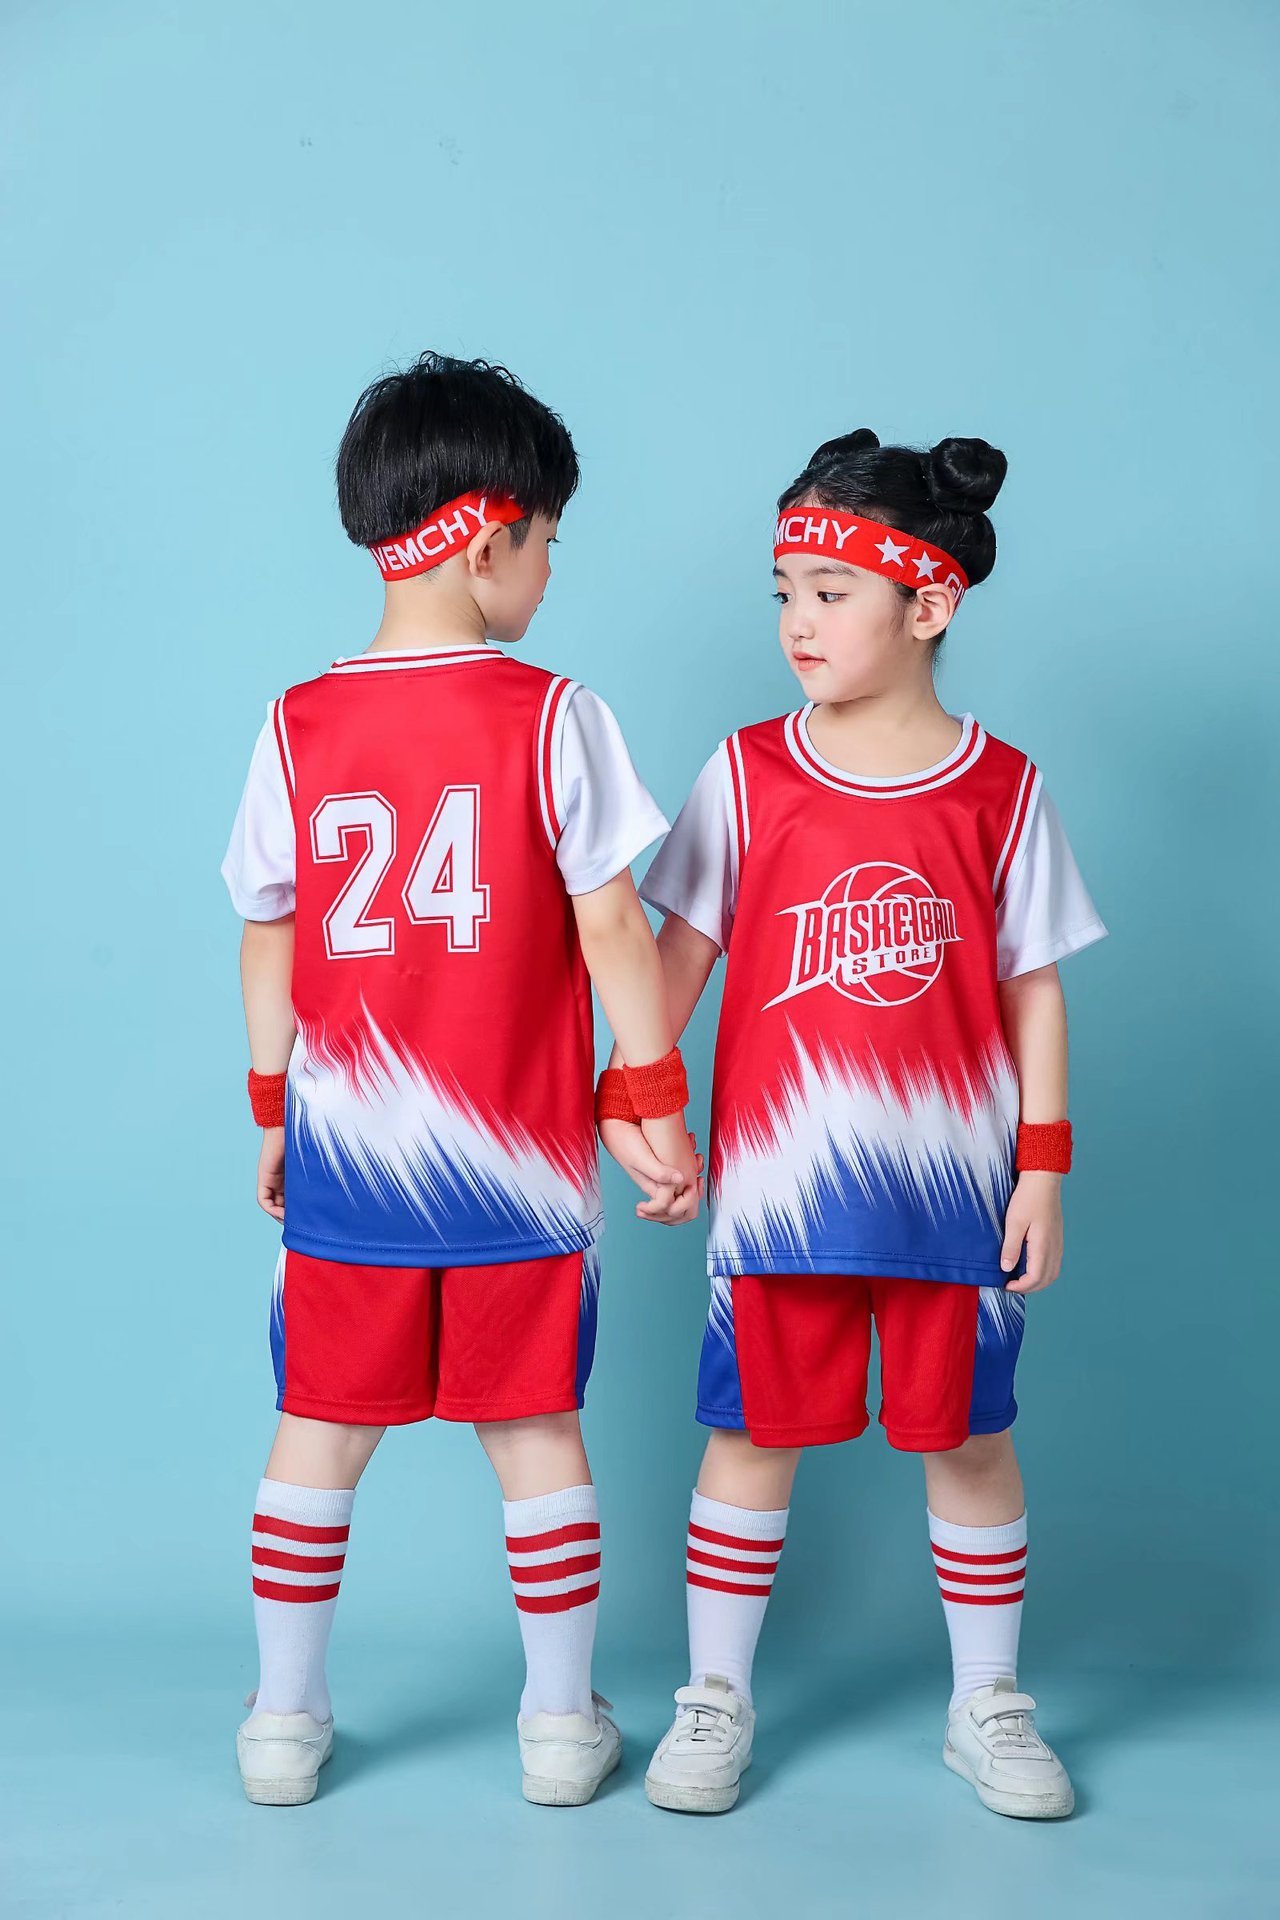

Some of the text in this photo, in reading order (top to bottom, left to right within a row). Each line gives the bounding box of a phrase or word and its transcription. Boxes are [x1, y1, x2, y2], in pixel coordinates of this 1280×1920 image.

[309, 784, 491, 960] 24
[775, 893, 963, 1000] BASKETBALL
[851, 946, 932, 975] STORE
